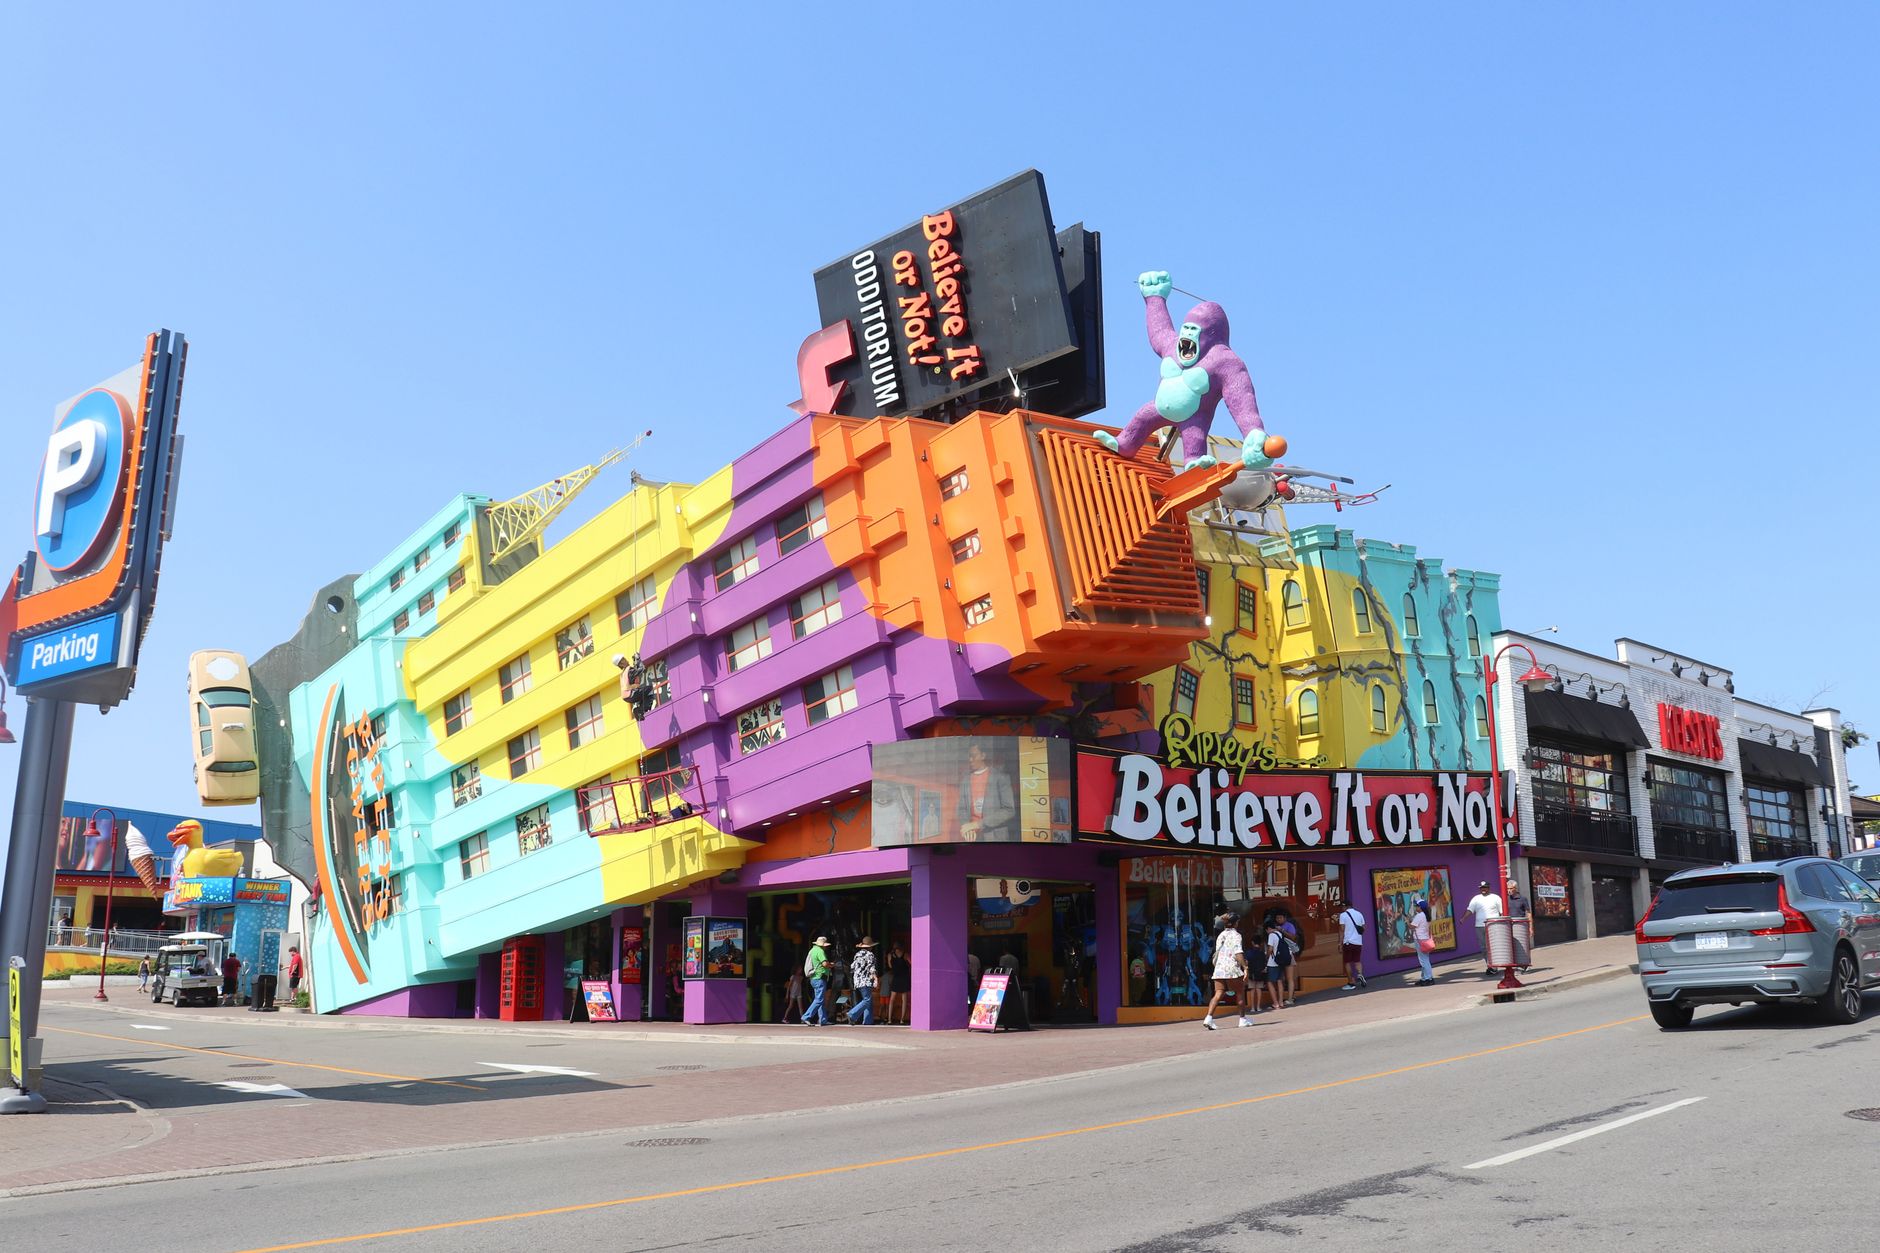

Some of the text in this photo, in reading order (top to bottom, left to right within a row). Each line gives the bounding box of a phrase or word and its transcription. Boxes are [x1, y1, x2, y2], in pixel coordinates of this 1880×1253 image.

[852, 250, 900, 408] ODDITORIUM
[892, 250, 945, 366] or Not!
[922, 210, 981, 381] Believe It
[37, 418, 108, 538] P
[31, 631, 99, 670] Parking
[343, 714, 375, 932] TOWERS
[1111, 754, 1516, 850] Believe It or Not!
[245, 881, 281, 891] WINNER
